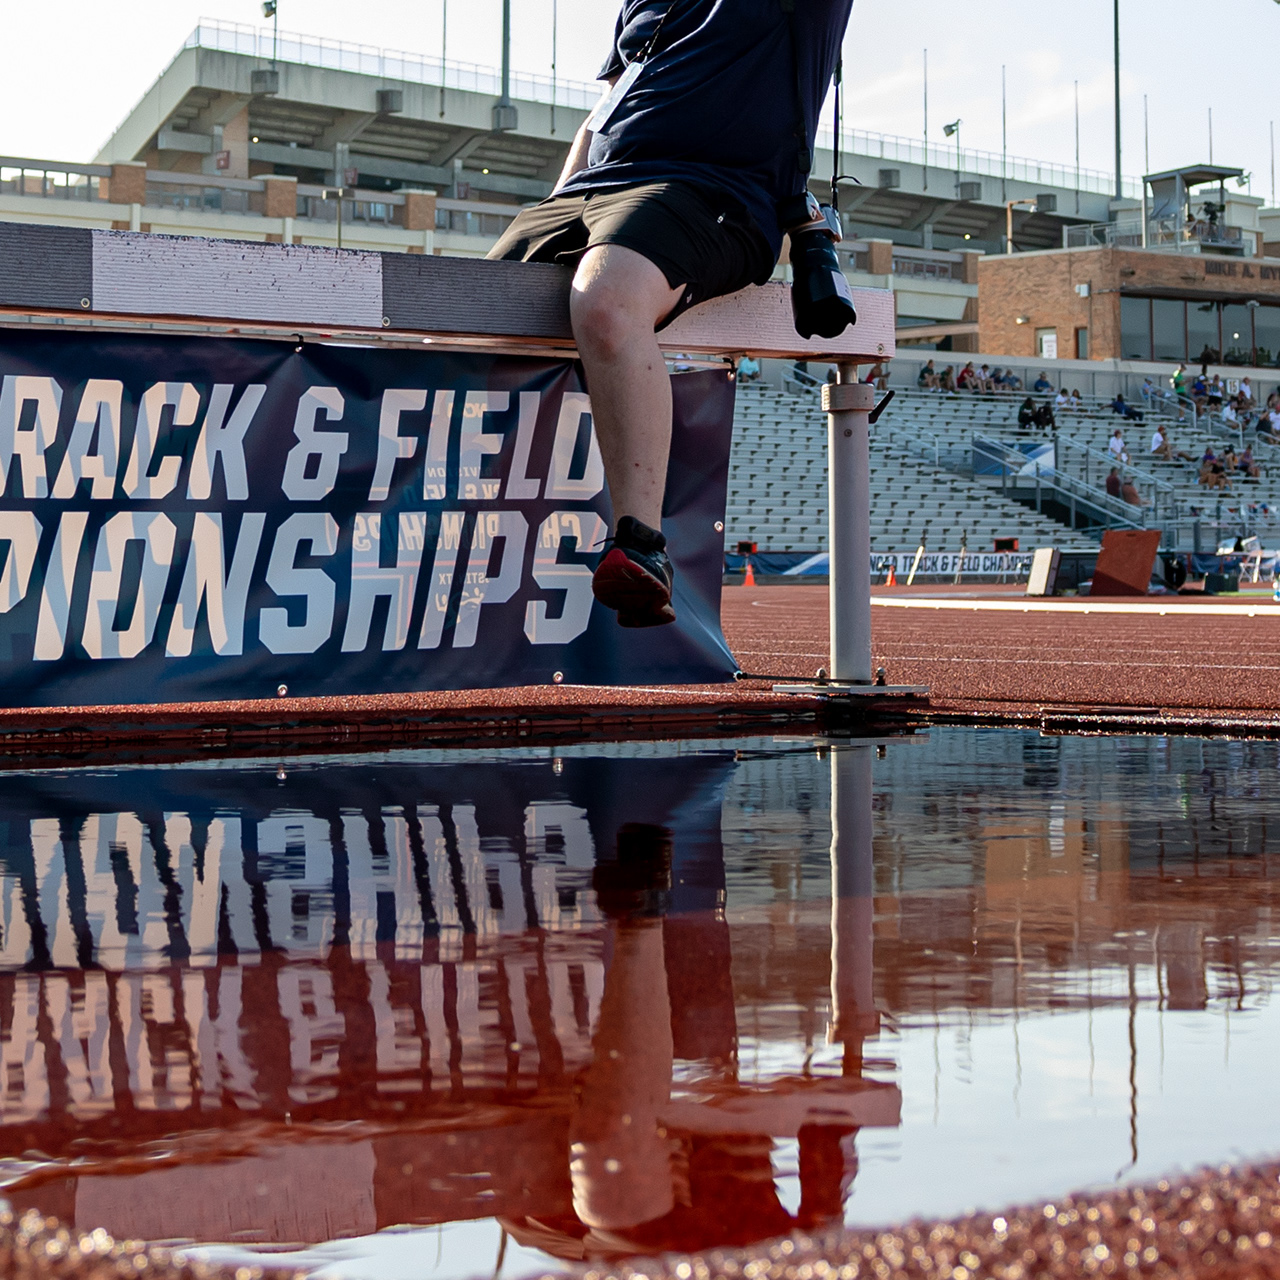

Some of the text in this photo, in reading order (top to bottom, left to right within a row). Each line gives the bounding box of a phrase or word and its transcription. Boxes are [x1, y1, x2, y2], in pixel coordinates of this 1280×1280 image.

[281, 386, 347, 502] &
[367, 389, 607, 501] FIELD
[940, 555, 949, 572] &
